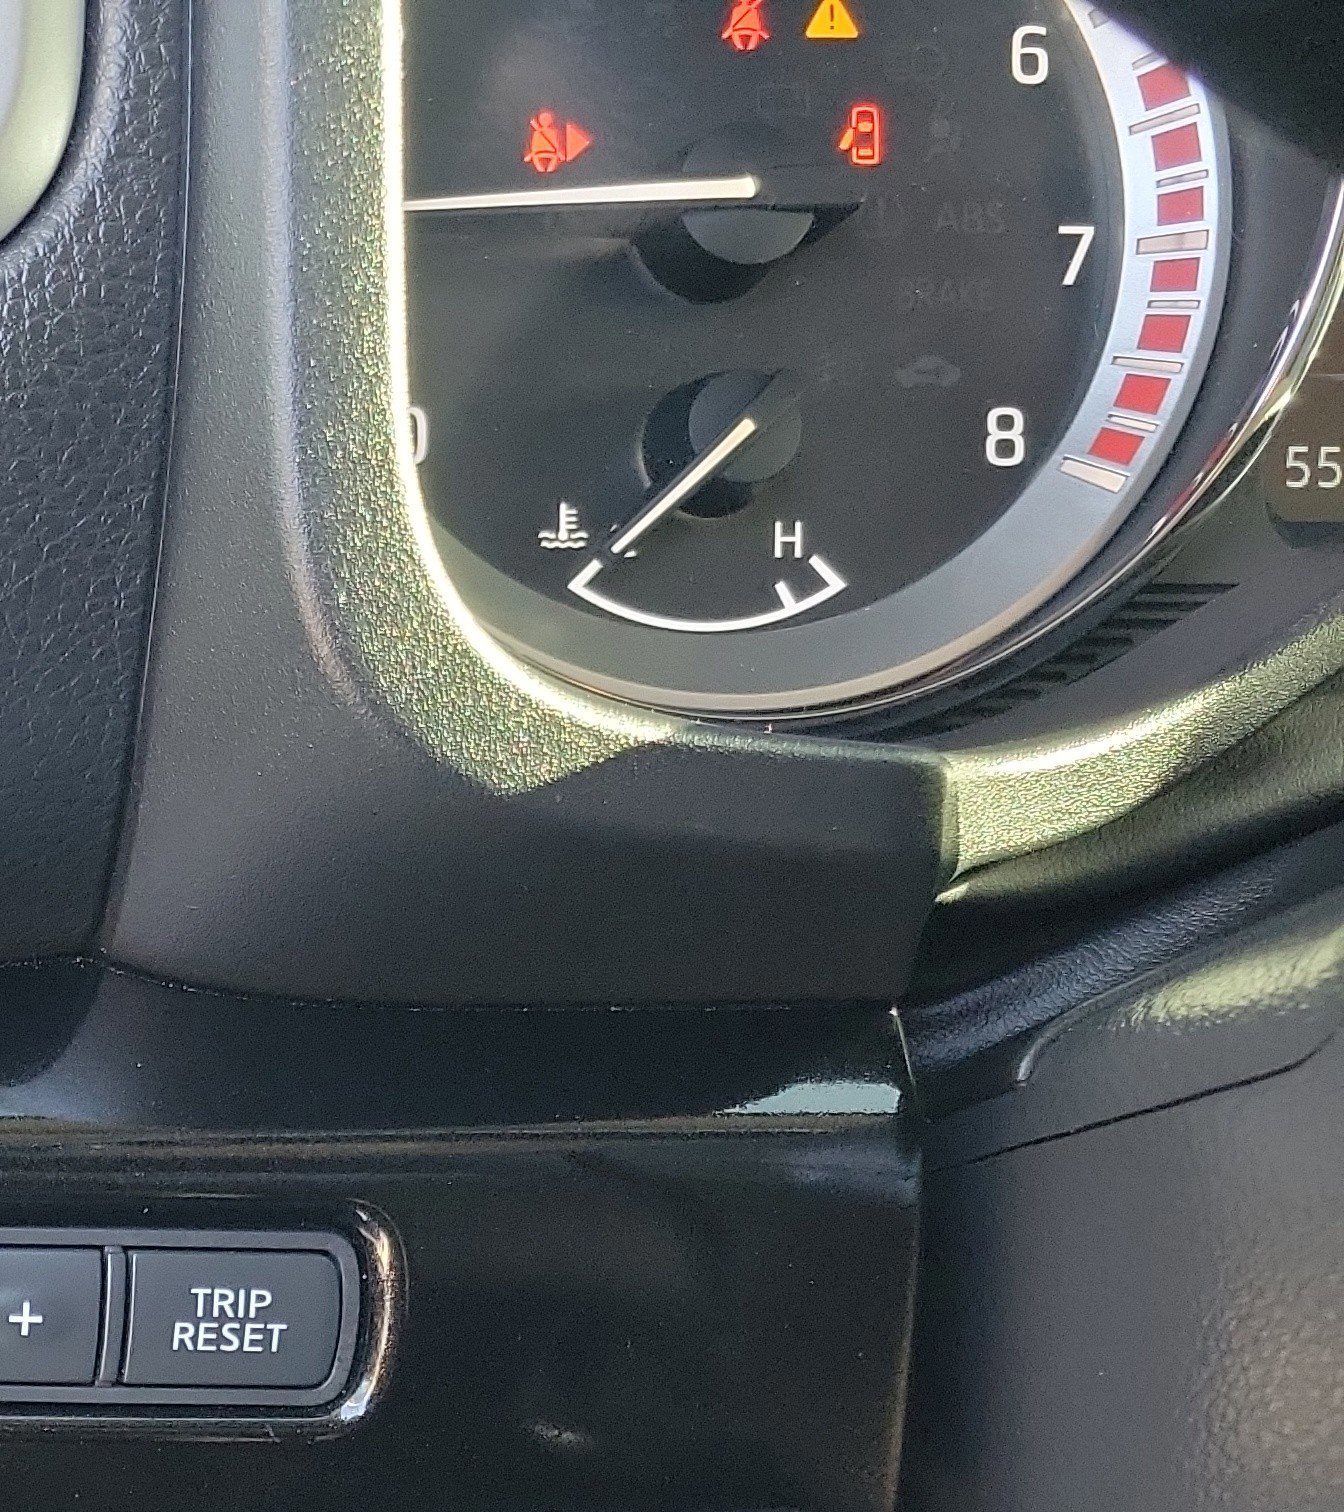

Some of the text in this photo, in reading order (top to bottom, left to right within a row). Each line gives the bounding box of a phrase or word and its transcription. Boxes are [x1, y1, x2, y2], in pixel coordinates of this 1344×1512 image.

[1011, 25, 1049, 85] 6
[935, 201, 1008, 235] ABS
[1057, 225, 1095, 286] 7
[985, 406, 1025, 467] 8
[1285, 445, 1343, 488] 55
[774, 520, 805, 559] H
[190, 1286, 273, 1319] TRIP
[172, 1321, 289, 1353] RESET
